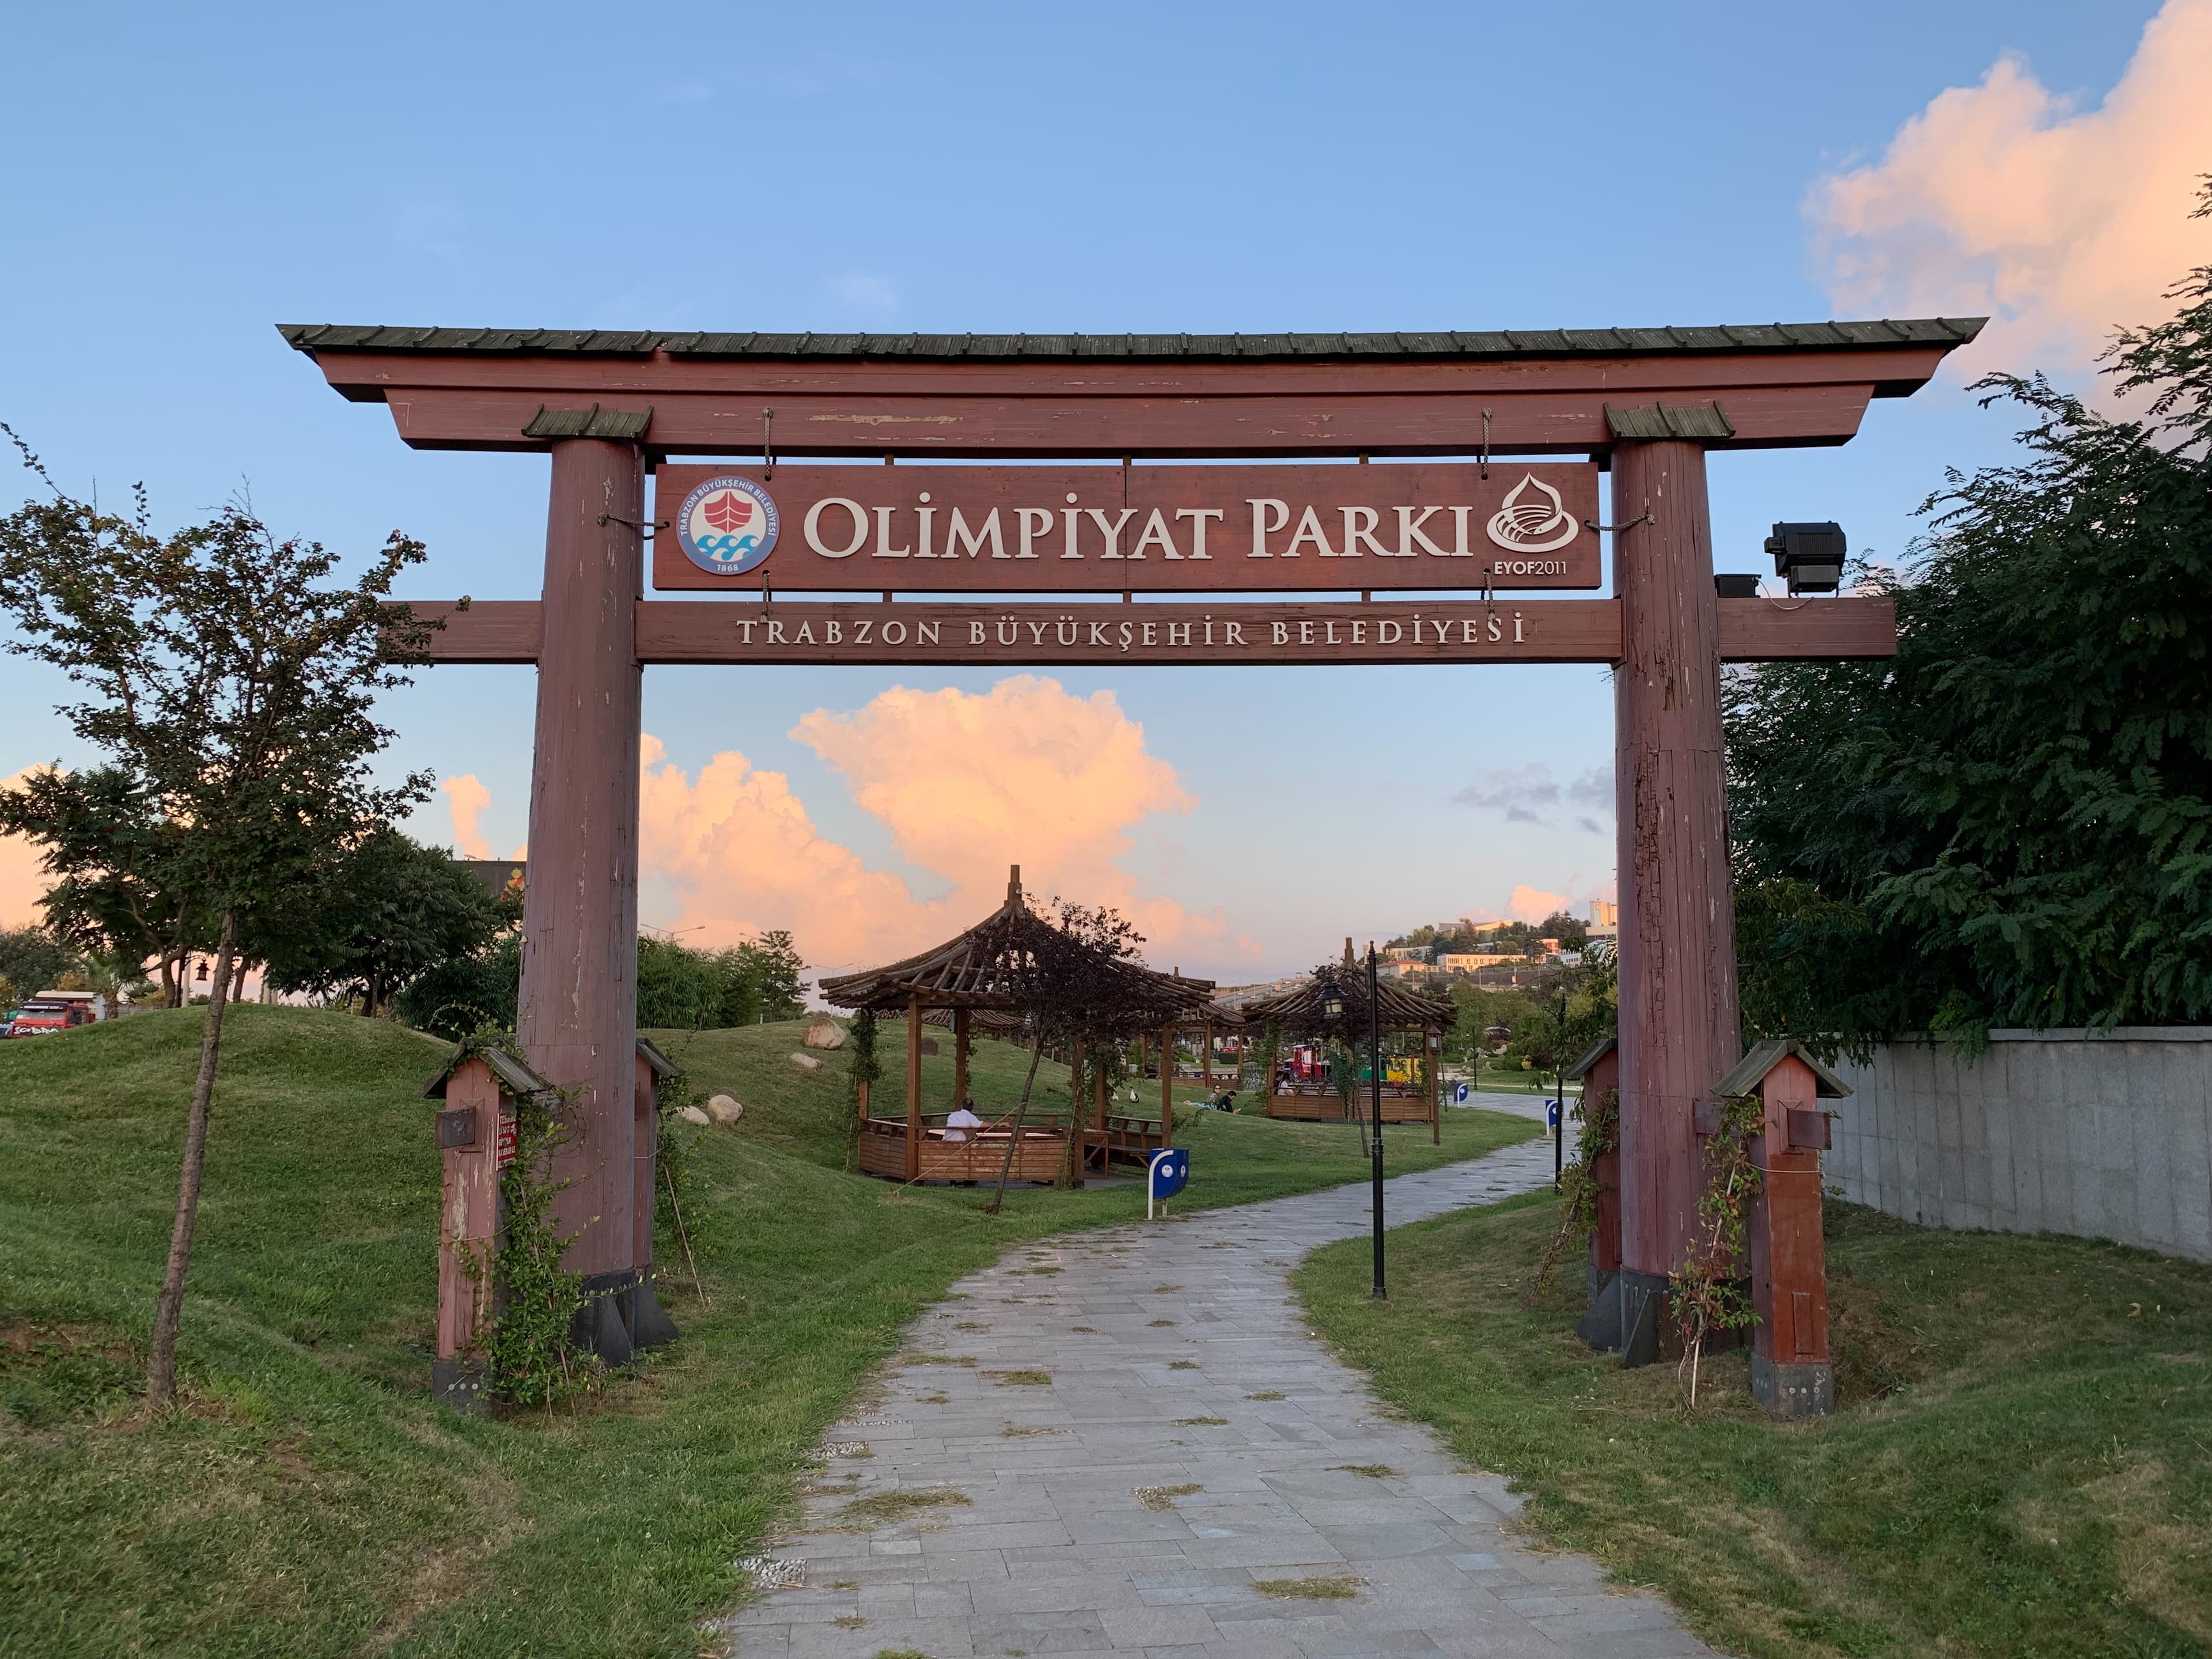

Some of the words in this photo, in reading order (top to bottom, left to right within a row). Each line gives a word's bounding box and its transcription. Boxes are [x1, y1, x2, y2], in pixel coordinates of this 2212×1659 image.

[680, 494, 699, 536] TRABZON
[696, 479, 755, 497] BÜYÜKŞEHİR
[803, 491, 1224, 560] OLİMPİYAT
[1245, 498, 1474, 558] PARKI
[717, 564, 739, 572] 1868
[1494, 560, 1567, 574] EYOF2011
[736, 620, 942, 645] TRABZON
[968, 615, 1249, 653] BÜYÜKŞEHİR
[1270, 612, 1526, 645] BELEDİYESİ
